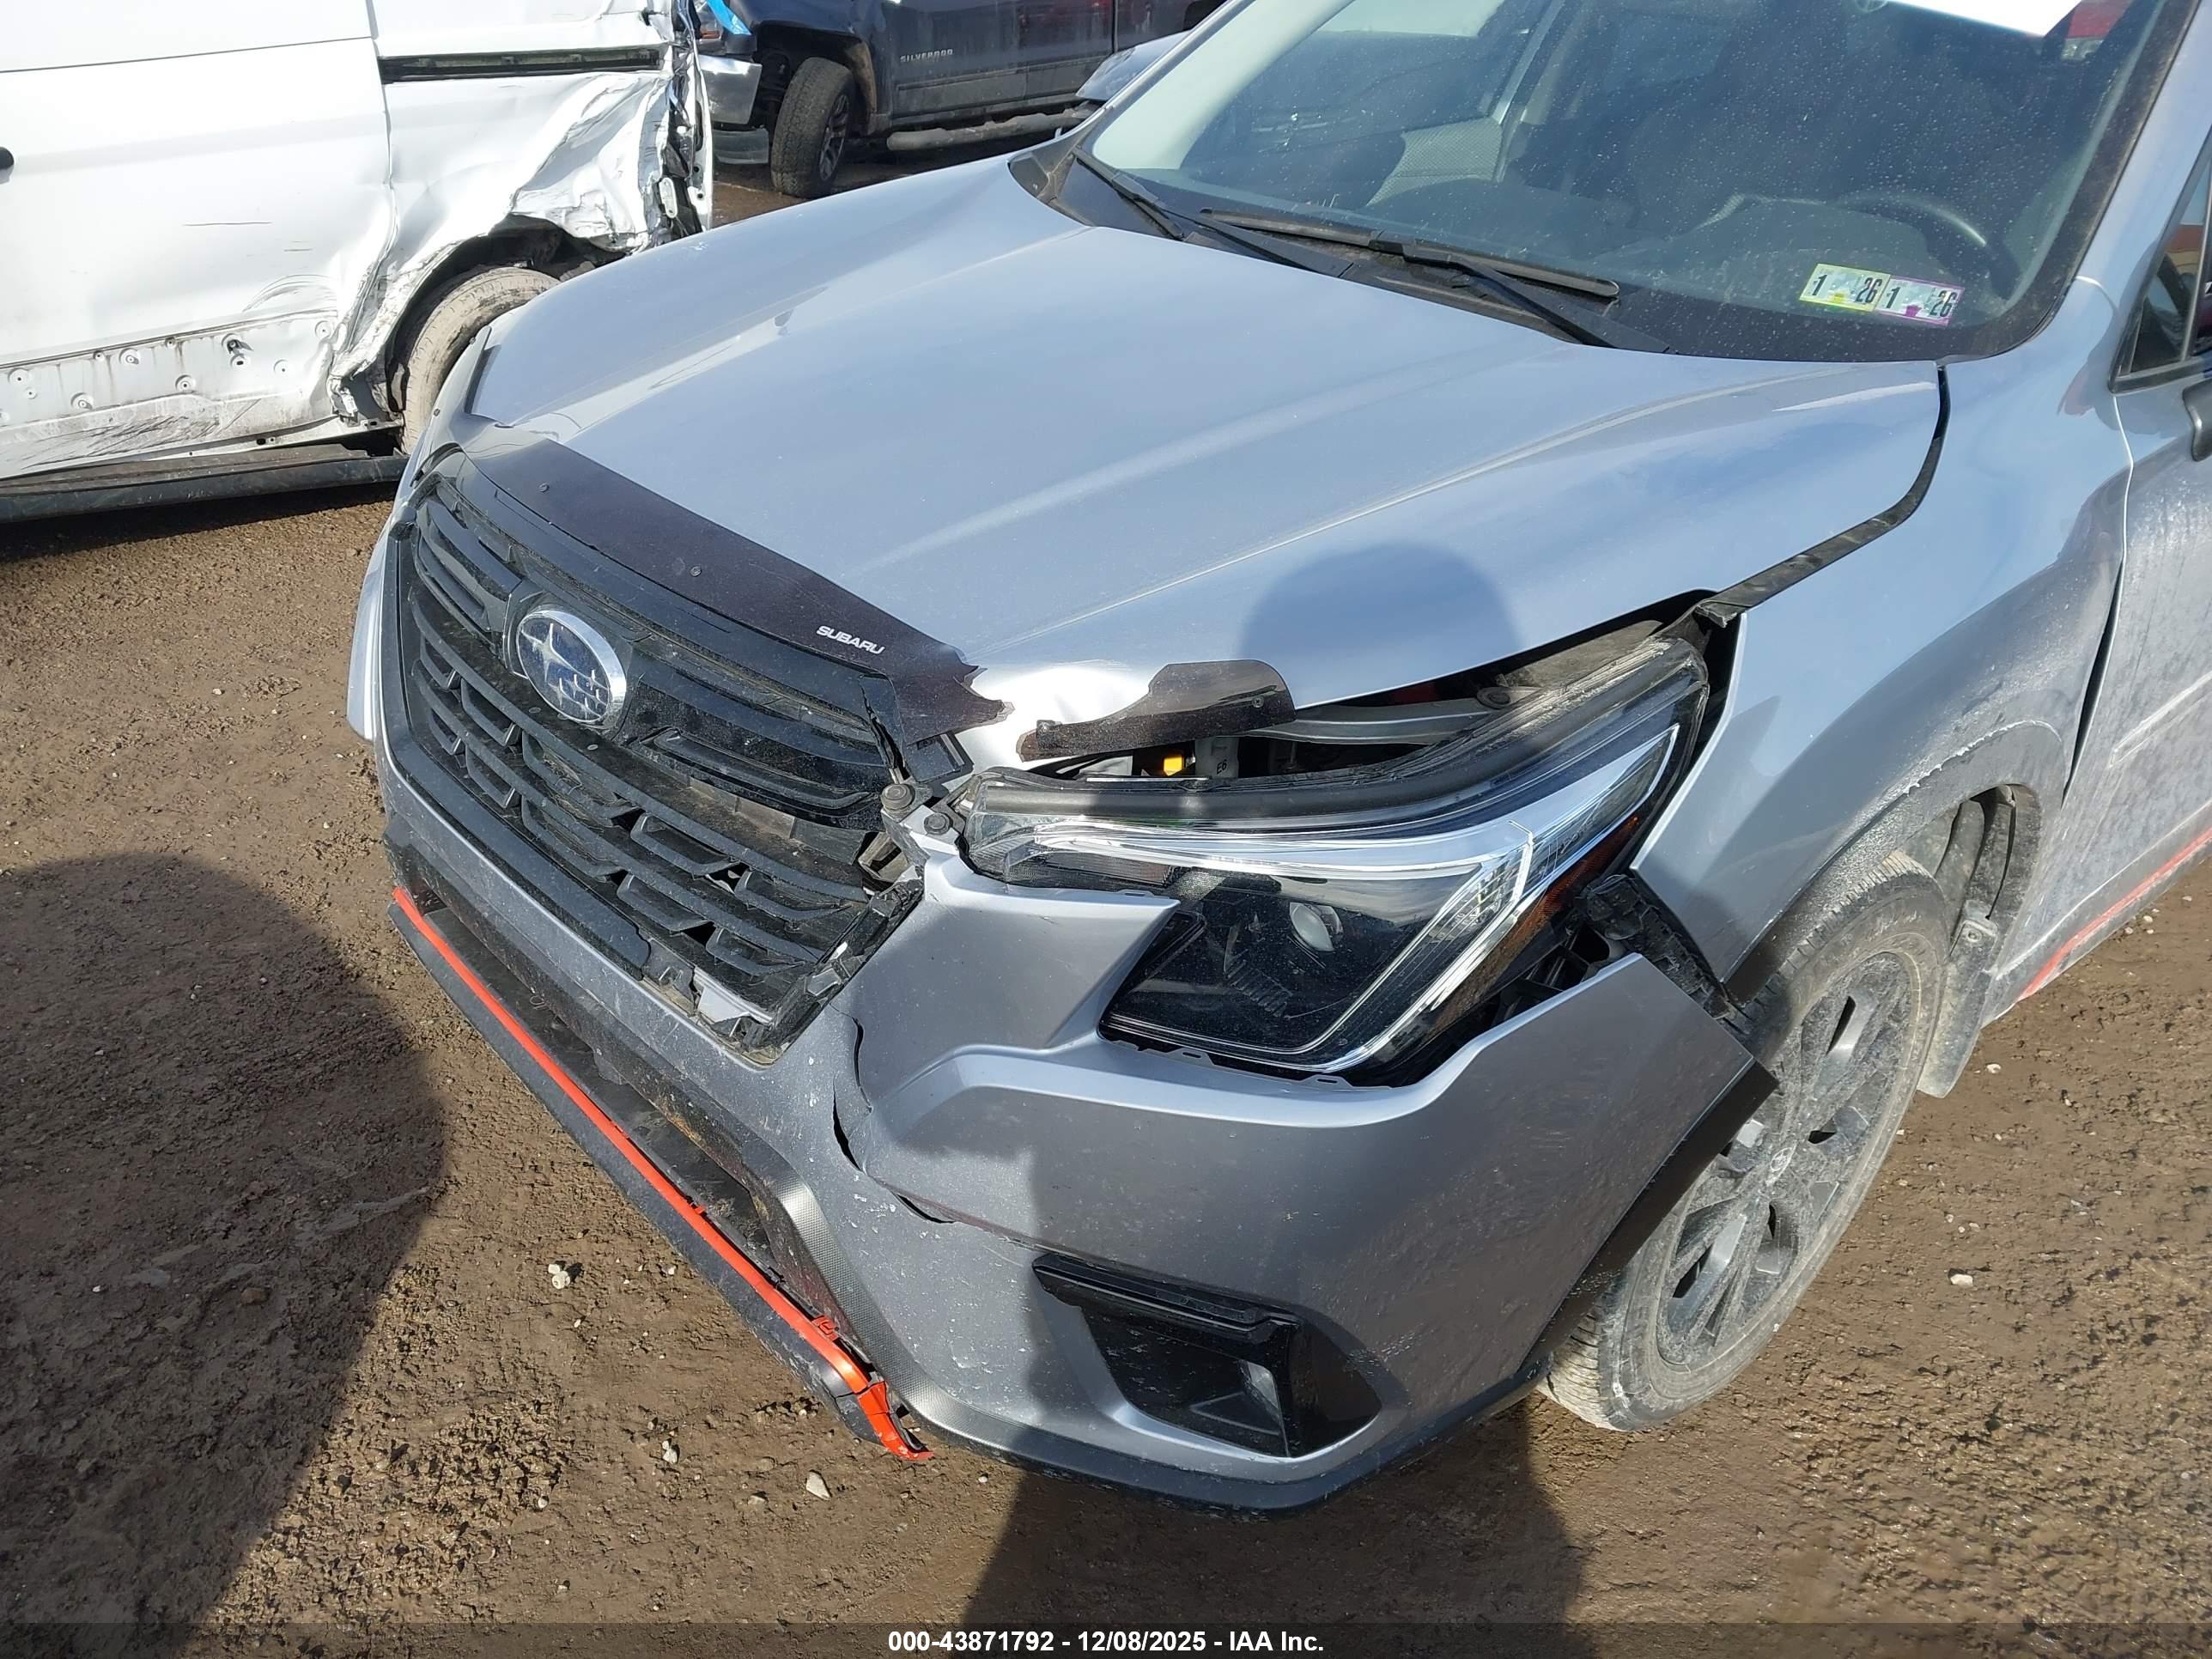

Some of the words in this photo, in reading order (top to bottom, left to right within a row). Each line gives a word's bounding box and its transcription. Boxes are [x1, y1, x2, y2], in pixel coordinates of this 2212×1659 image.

[1812, 274, 1827, 296] 1
[1854, 276, 1882, 304] 26
[1886, 286, 1901, 309] 1
[1929, 289, 1957, 318] 26
[816, 625, 885, 654] SUBARU
